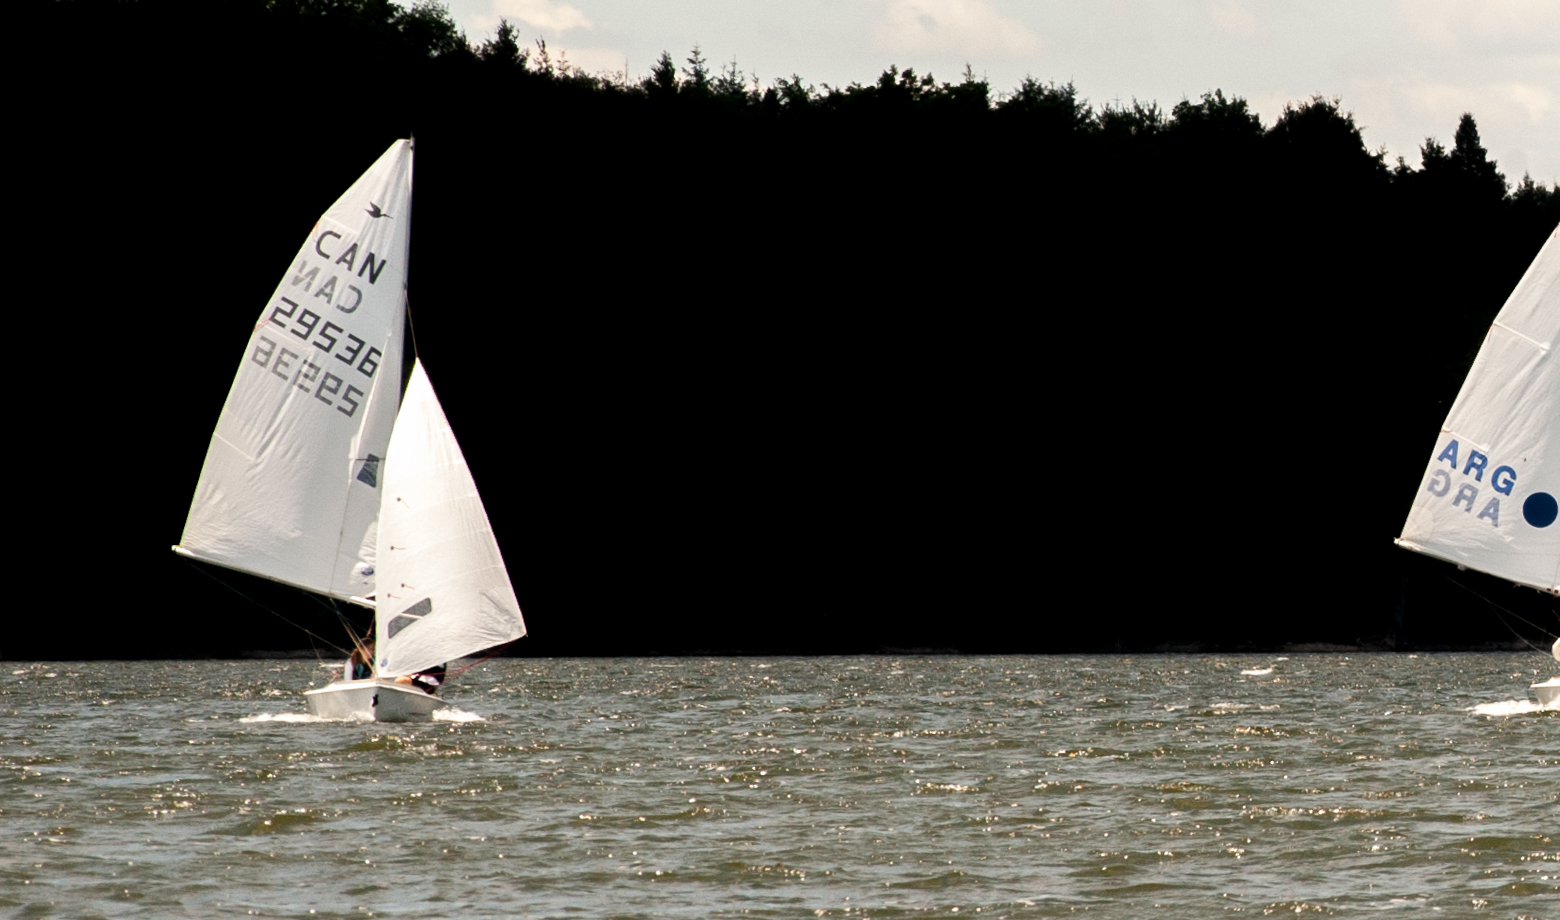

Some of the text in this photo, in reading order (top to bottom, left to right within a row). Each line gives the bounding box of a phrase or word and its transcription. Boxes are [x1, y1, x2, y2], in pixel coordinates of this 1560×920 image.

[315, 230, 386, 285] CAN
[269, 296, 382, 378] 29536
[1437, 439, 1517, 497] ARG
